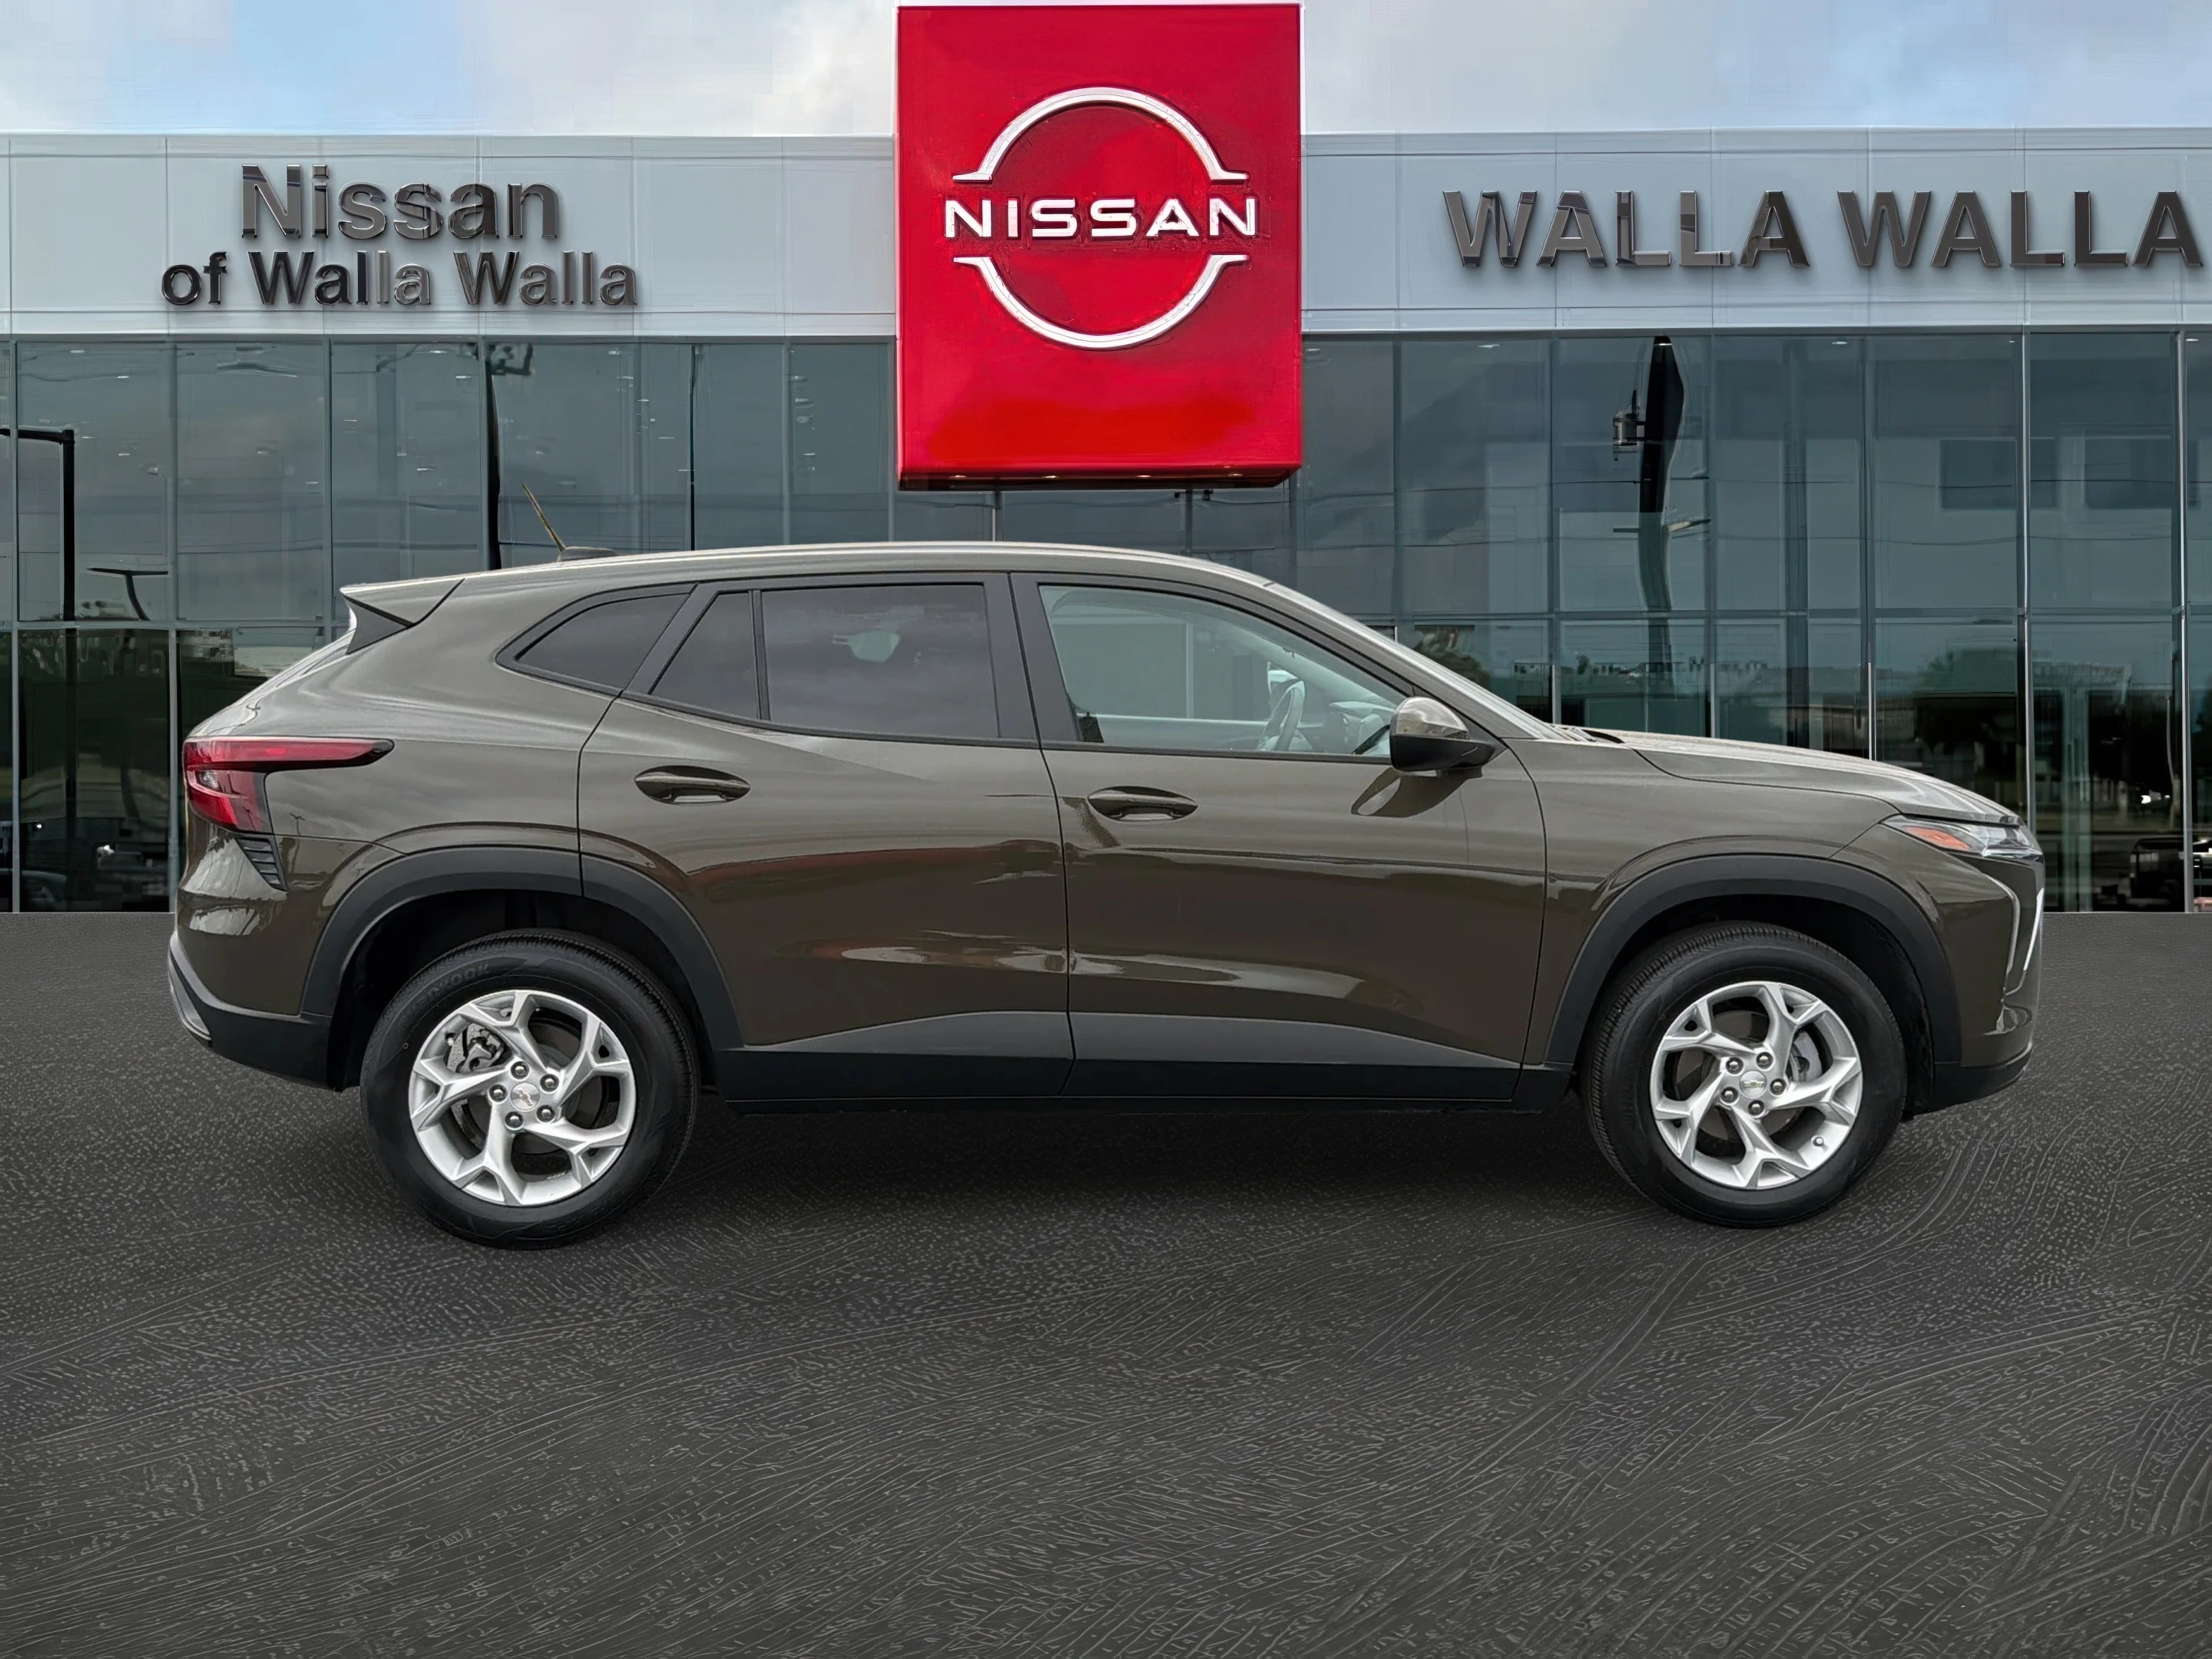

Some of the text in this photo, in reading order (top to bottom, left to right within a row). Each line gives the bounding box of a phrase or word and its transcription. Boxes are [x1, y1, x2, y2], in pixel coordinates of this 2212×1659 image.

[240, 163, 561, 240] Nissan
[945, 197, 1258, 238] NISSAN
[1442, 189, 2206, 268] WALLA WALLA
[161, 250, 638, 306] of Walla Walla
